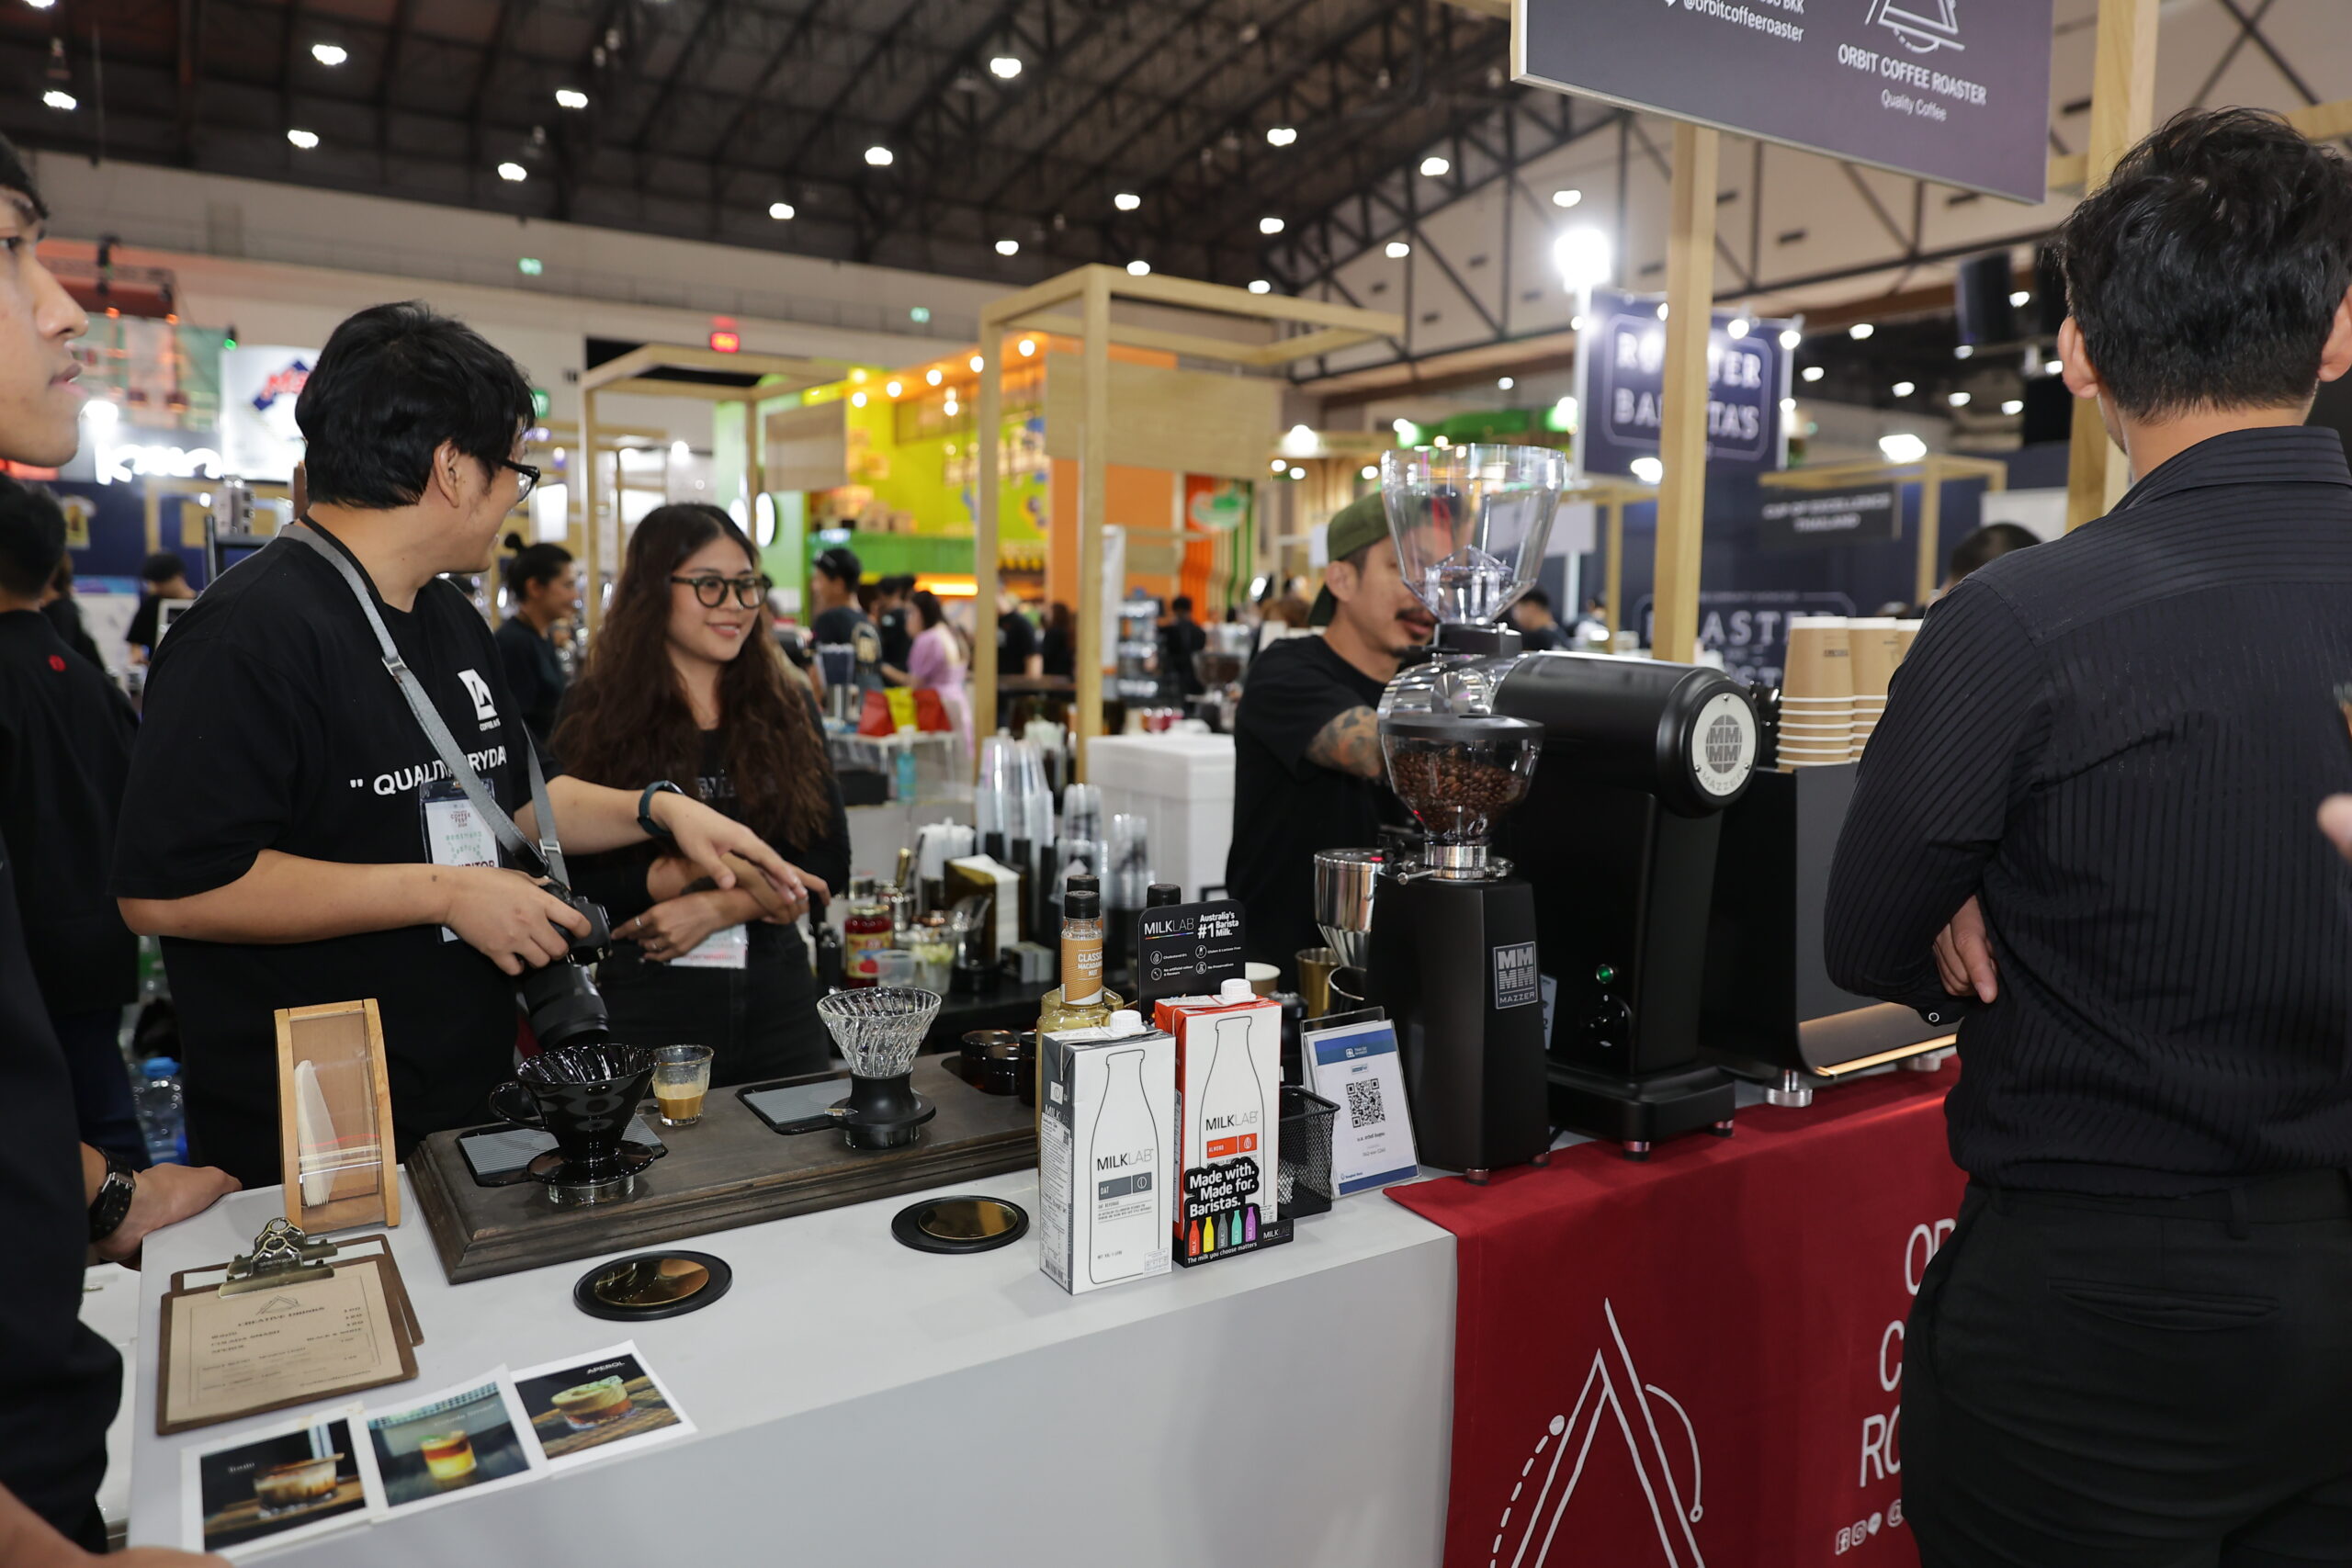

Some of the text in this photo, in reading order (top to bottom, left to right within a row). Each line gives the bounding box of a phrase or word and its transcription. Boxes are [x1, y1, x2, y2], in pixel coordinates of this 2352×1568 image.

[1838, 43, 1987, 107] ORBIT COFFEE ROASTER
[1881, 89, 1947, 122] Quality Coffee
[1199, 911, 1235, 922] Australia's
[1216, 919, 1239, 930] Barista
[1144, 918, 1194, 935] MILKLAB
[1197, 922, 1214, 940] #1
[1216, 928, 1233, 937] Milk.
[1499, 991, 1535, 1004] MAZZER
[1205, 1111, 1258, 1132] MILKLAB
[1097, 1148, 1154, 1171] MILKLAB
[1190, 1162, 1255, 1190] Made with.
[1100, 1185, 1110, 1195] OAT
[1200, 1178, 1255, 1201] Made for.
[1190, 1196, 1241, 1218] Baristas.
[1220, 1247, 1237, 1256] choose
[1238, 1242, 1257, 1251] matters
[586, 1361, 625, 1375] APEROL
